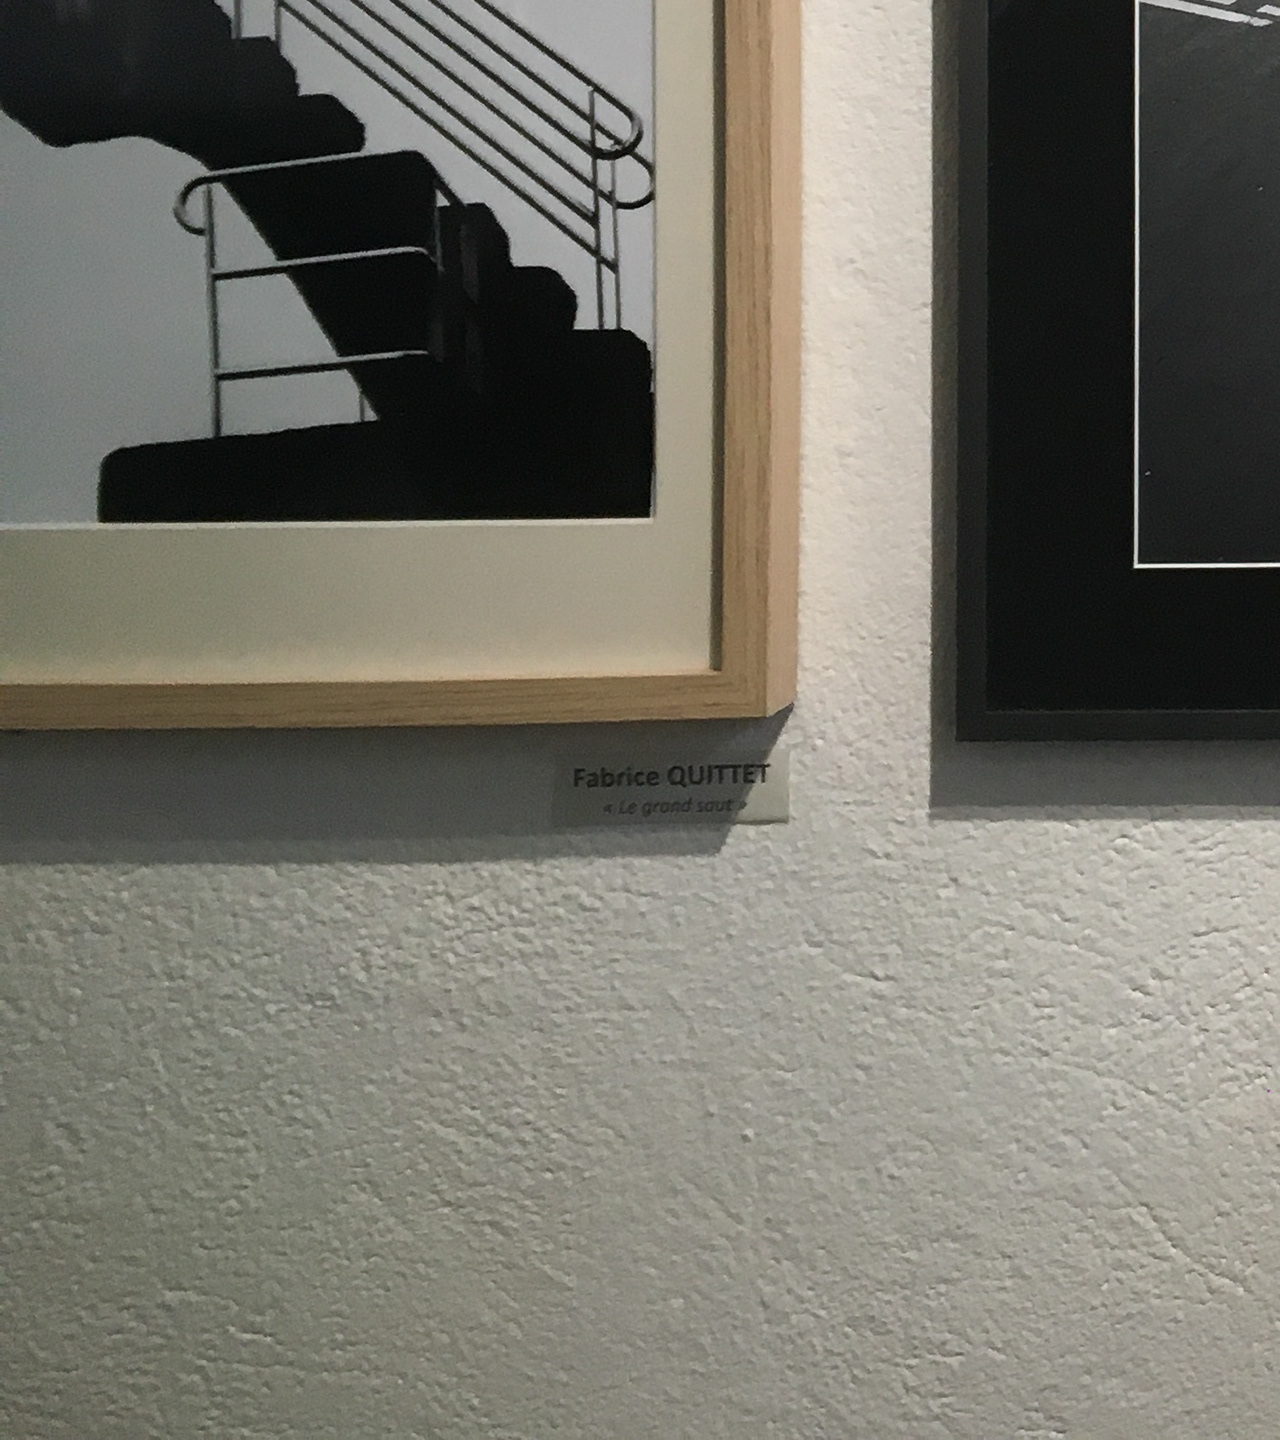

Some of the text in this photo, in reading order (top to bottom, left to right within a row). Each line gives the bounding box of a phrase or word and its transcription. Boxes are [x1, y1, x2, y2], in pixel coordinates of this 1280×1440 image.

[572, 762, 771, 789] Fabrice QUITTET
[618, 801, 637, 815] Le
[641, 796, 693, 818] grand
